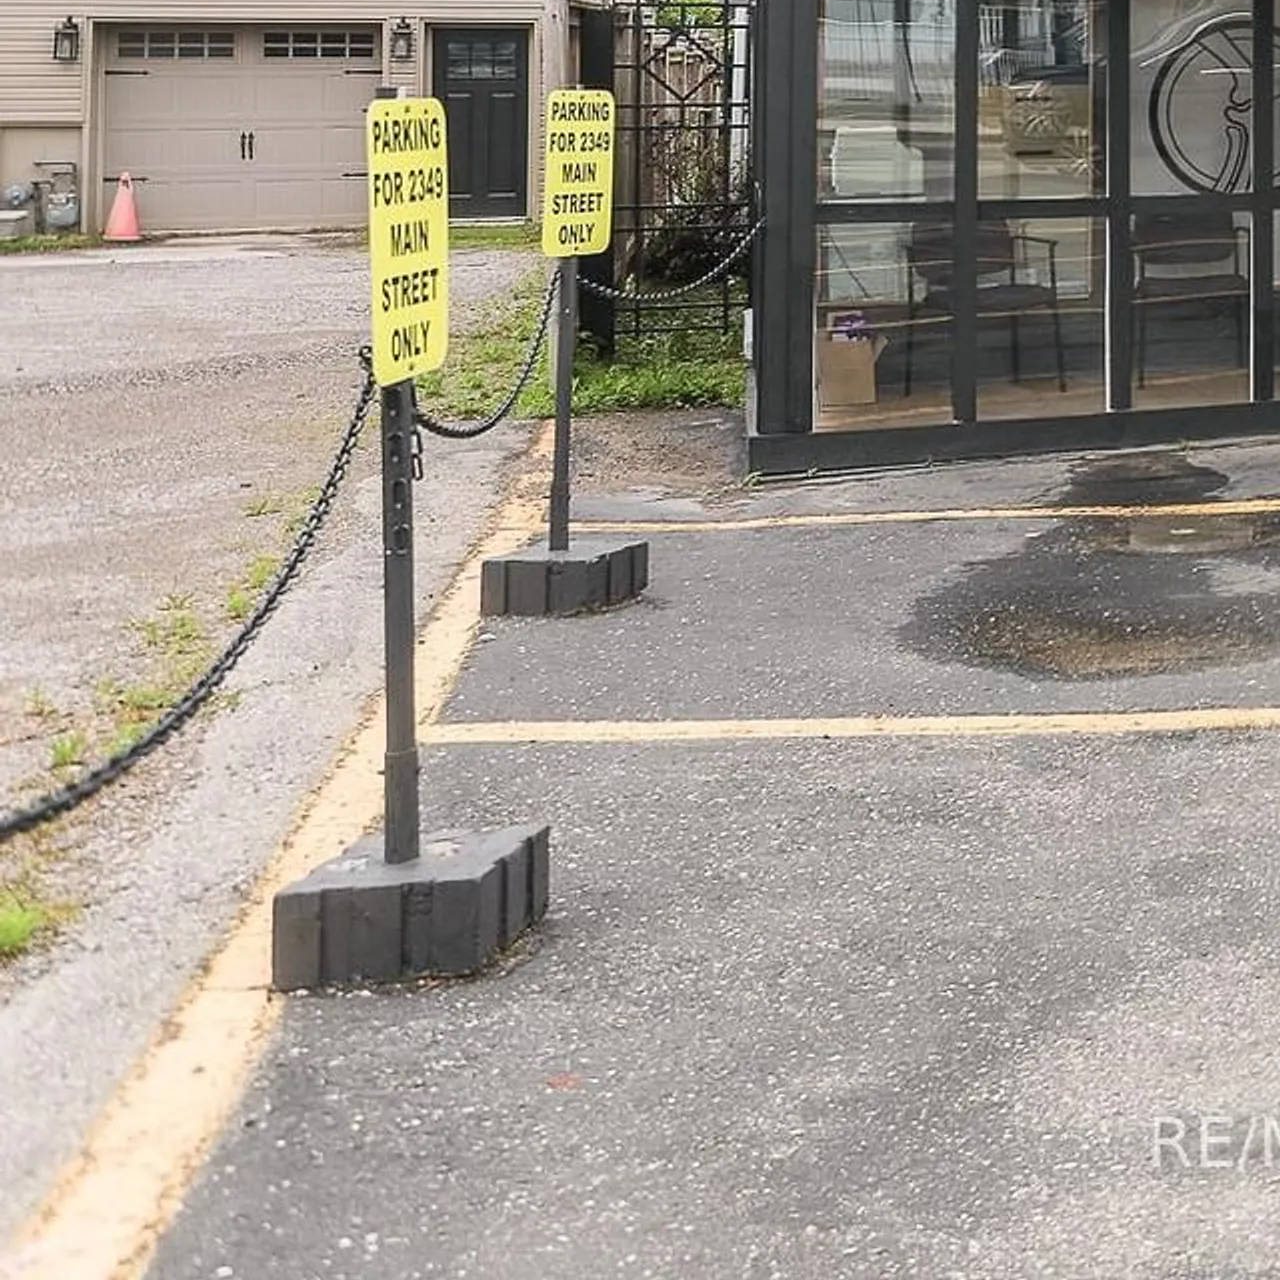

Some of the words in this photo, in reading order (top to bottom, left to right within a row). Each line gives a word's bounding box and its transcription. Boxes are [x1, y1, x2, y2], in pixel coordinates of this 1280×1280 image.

[551, 101, 610, 122] PARKING
[373, 118, 441, 154] PARKING
[550, 133, 577, 152] FOR
[580, 131, 610, 152] 2349
[562, 163, 597, 182] MAIN
[373, 174, 403, 208] FOR
[408, 168, 444, 201] 2349
[552, 193, 604, 215] STREET
[390, 221, 430, 257] MAIN
[559, 224, 596, 245] ONLY
[381, 268, 439, 312] STREET
[391, 320, 430, 362] ONLY
